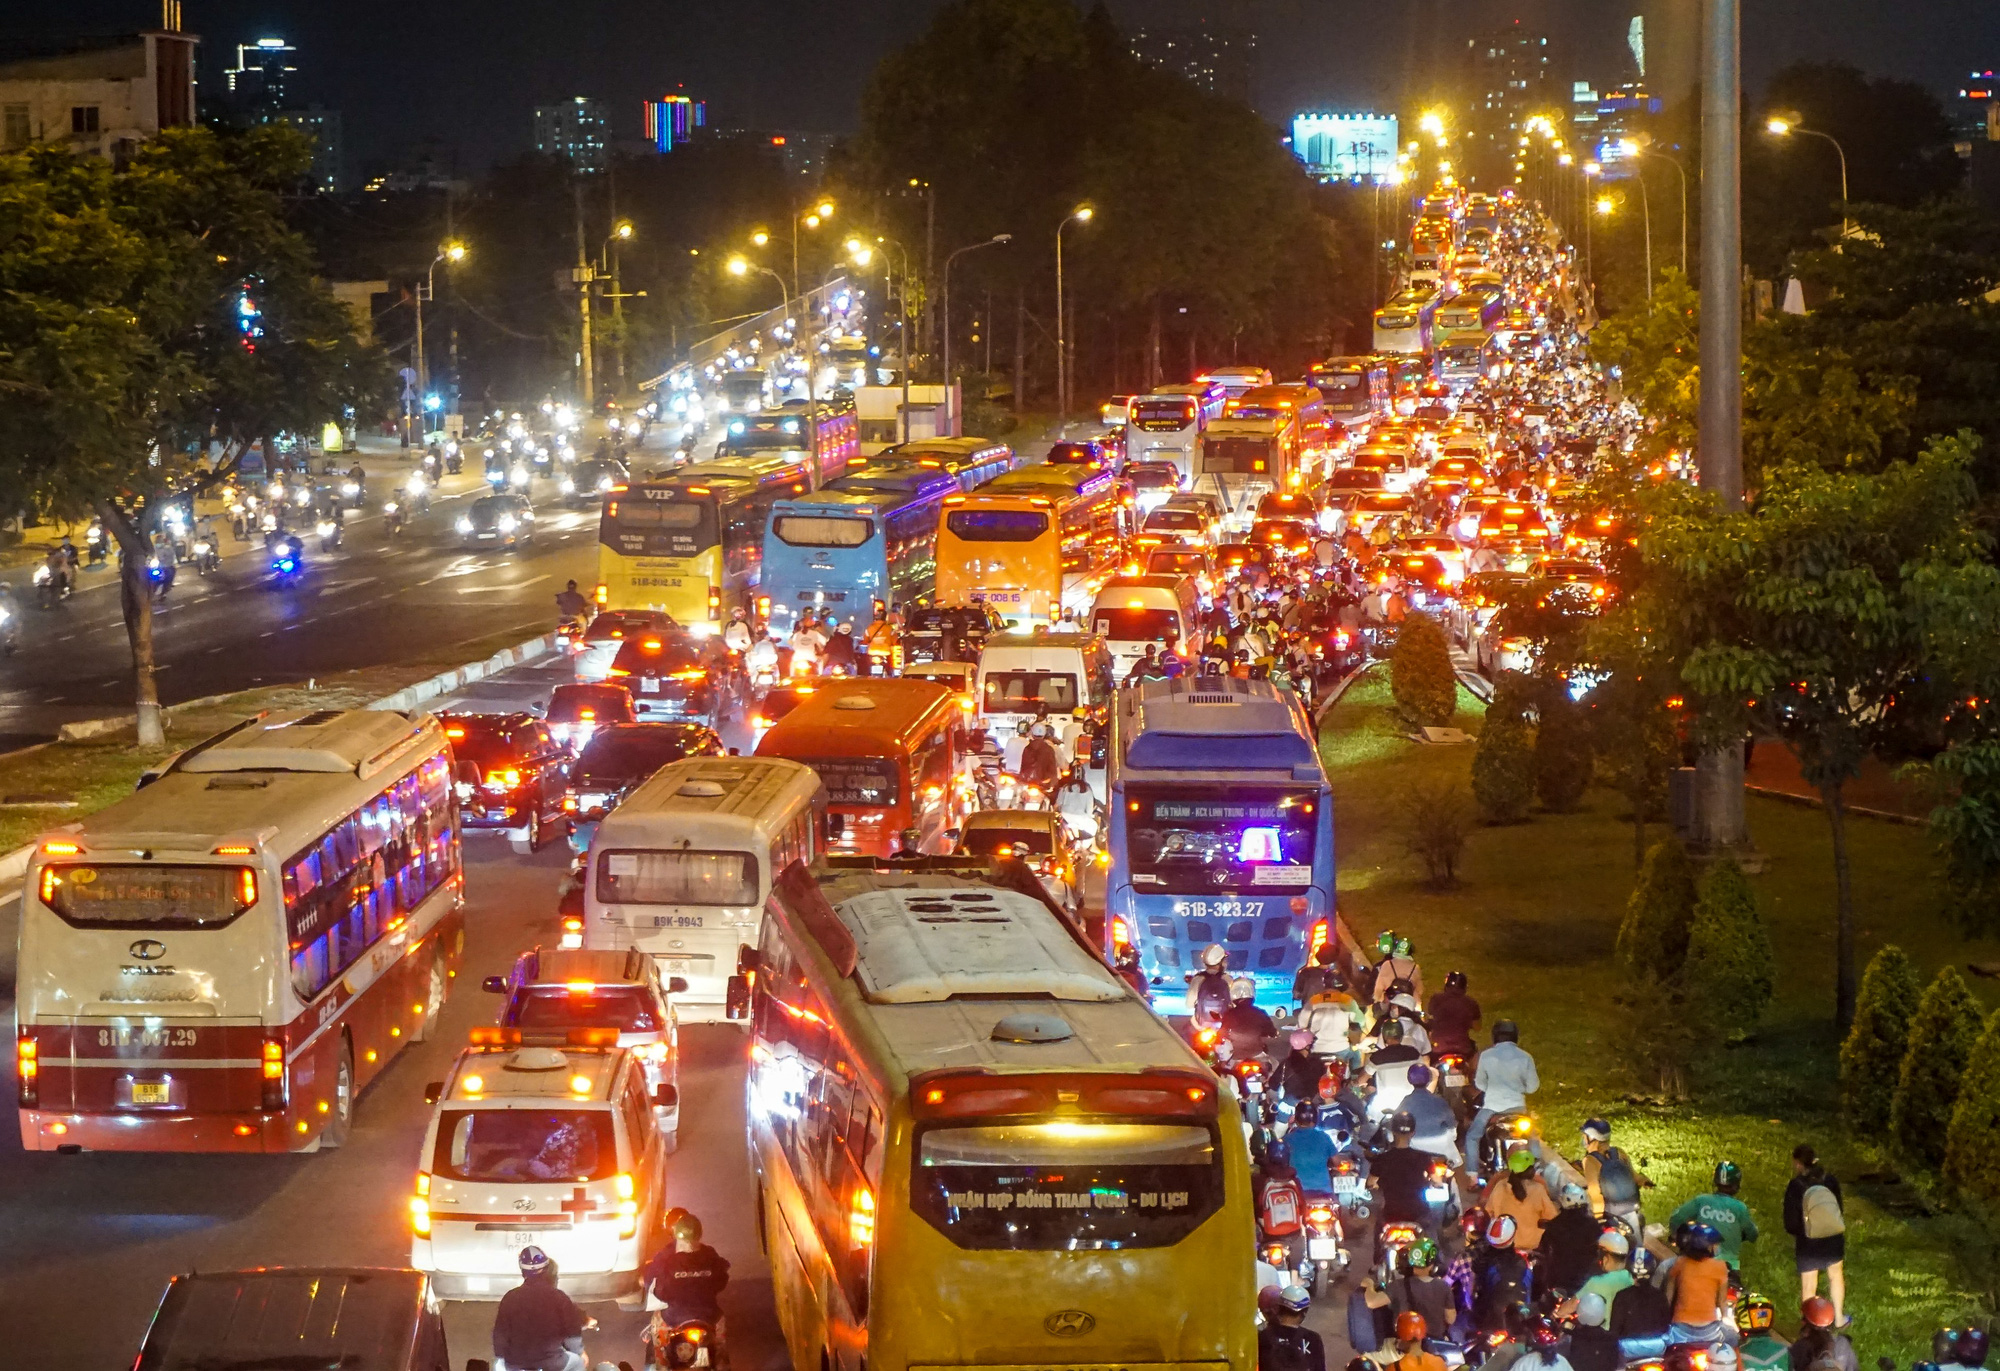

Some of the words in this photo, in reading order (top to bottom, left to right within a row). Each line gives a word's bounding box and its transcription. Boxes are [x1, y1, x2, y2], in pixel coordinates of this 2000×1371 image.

[644, 489, 675, 500] VIP
[1180, 902, 1264, 917] 51B-323.27
[654, 916, 704, 928] 89K-9943
[948, 1190, 985, 1210] NHẬN
[1055, 1193, 1091, 1208] THAM
[1140, 1193, 1158, 1207] DU
[1161, 1192, 1189, 1209] LỊCH
[1700, 1205, 1736, 1223] Grab
[515, 1233, 533, 1243] 93A
